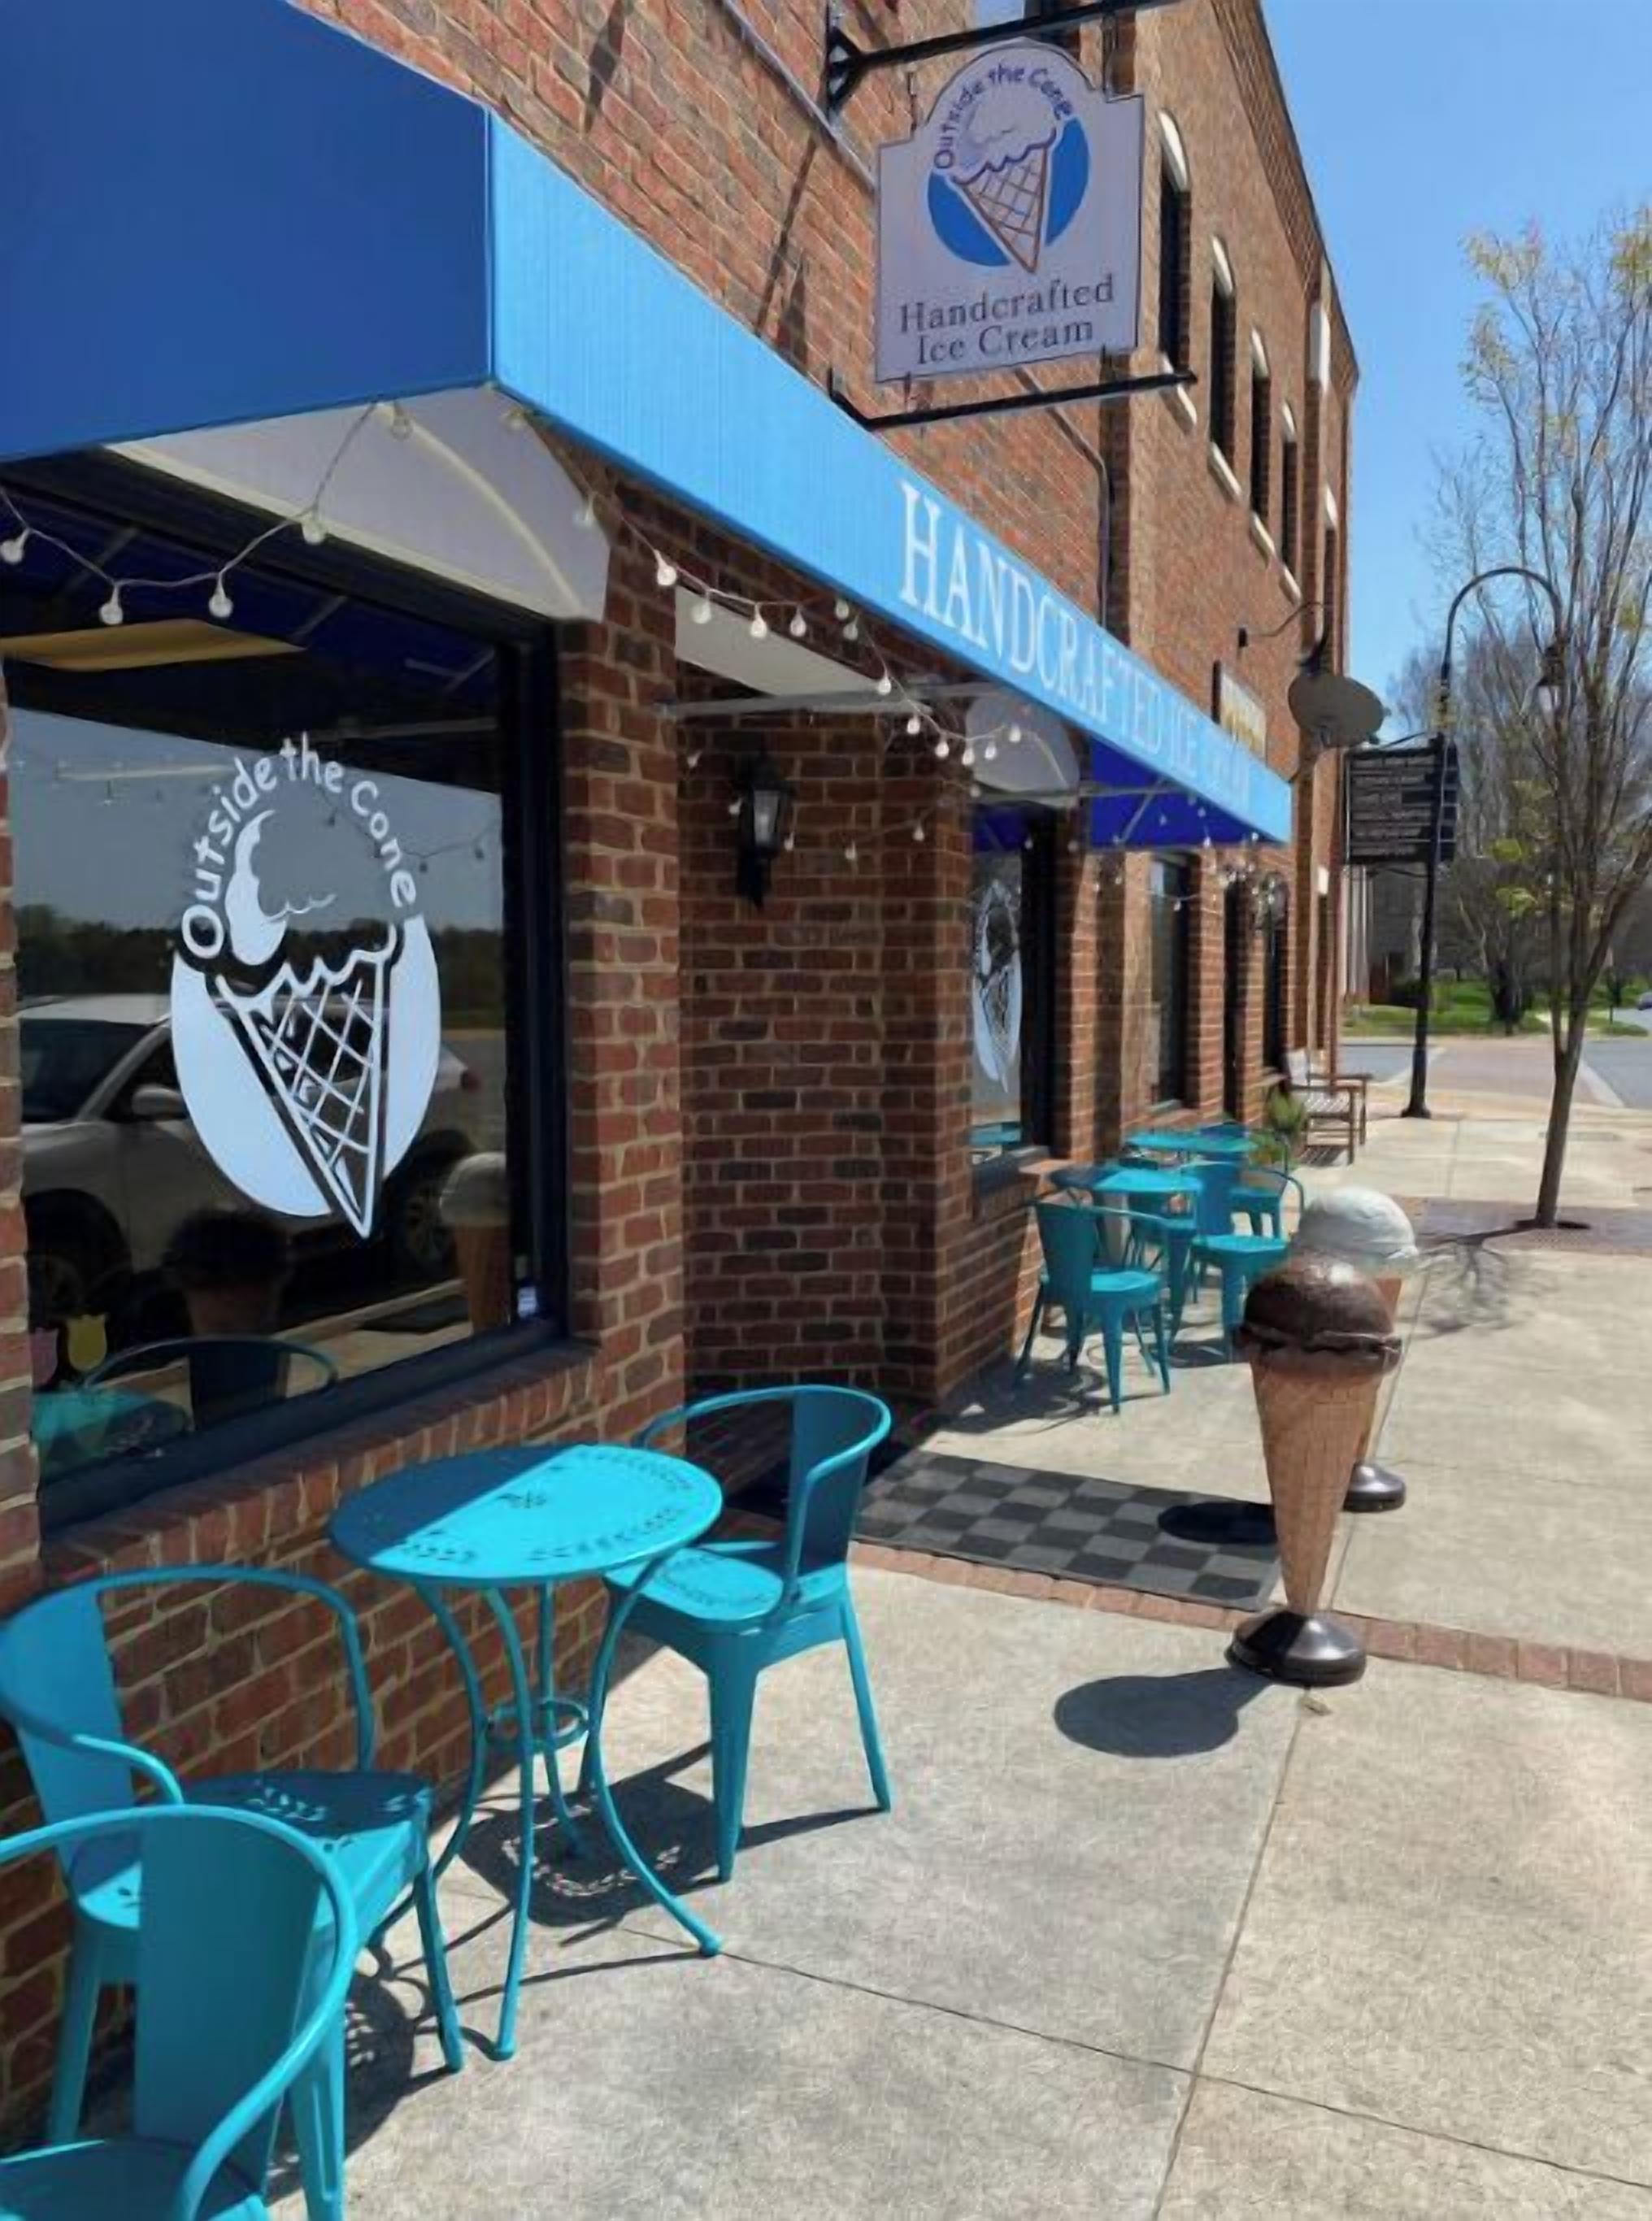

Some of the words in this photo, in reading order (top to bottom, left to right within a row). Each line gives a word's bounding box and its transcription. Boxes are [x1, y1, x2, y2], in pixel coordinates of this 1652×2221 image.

[933, 80, 985, 169] Outside
[987, 63, 1025, 85] the
[1028, 67, 1073, 121] Cone
[900, 273, 1114, 333] Handcrafted
[916, 334, 965, 365] Ice
[978, 320, 1093, 358] Cream
[899, 481, 1163, 757] HANDCRAFTED
[181, 756, 278, 959] Outside
[280, 731, 344, 793] the
[350, 780, 416, 908] Cone
